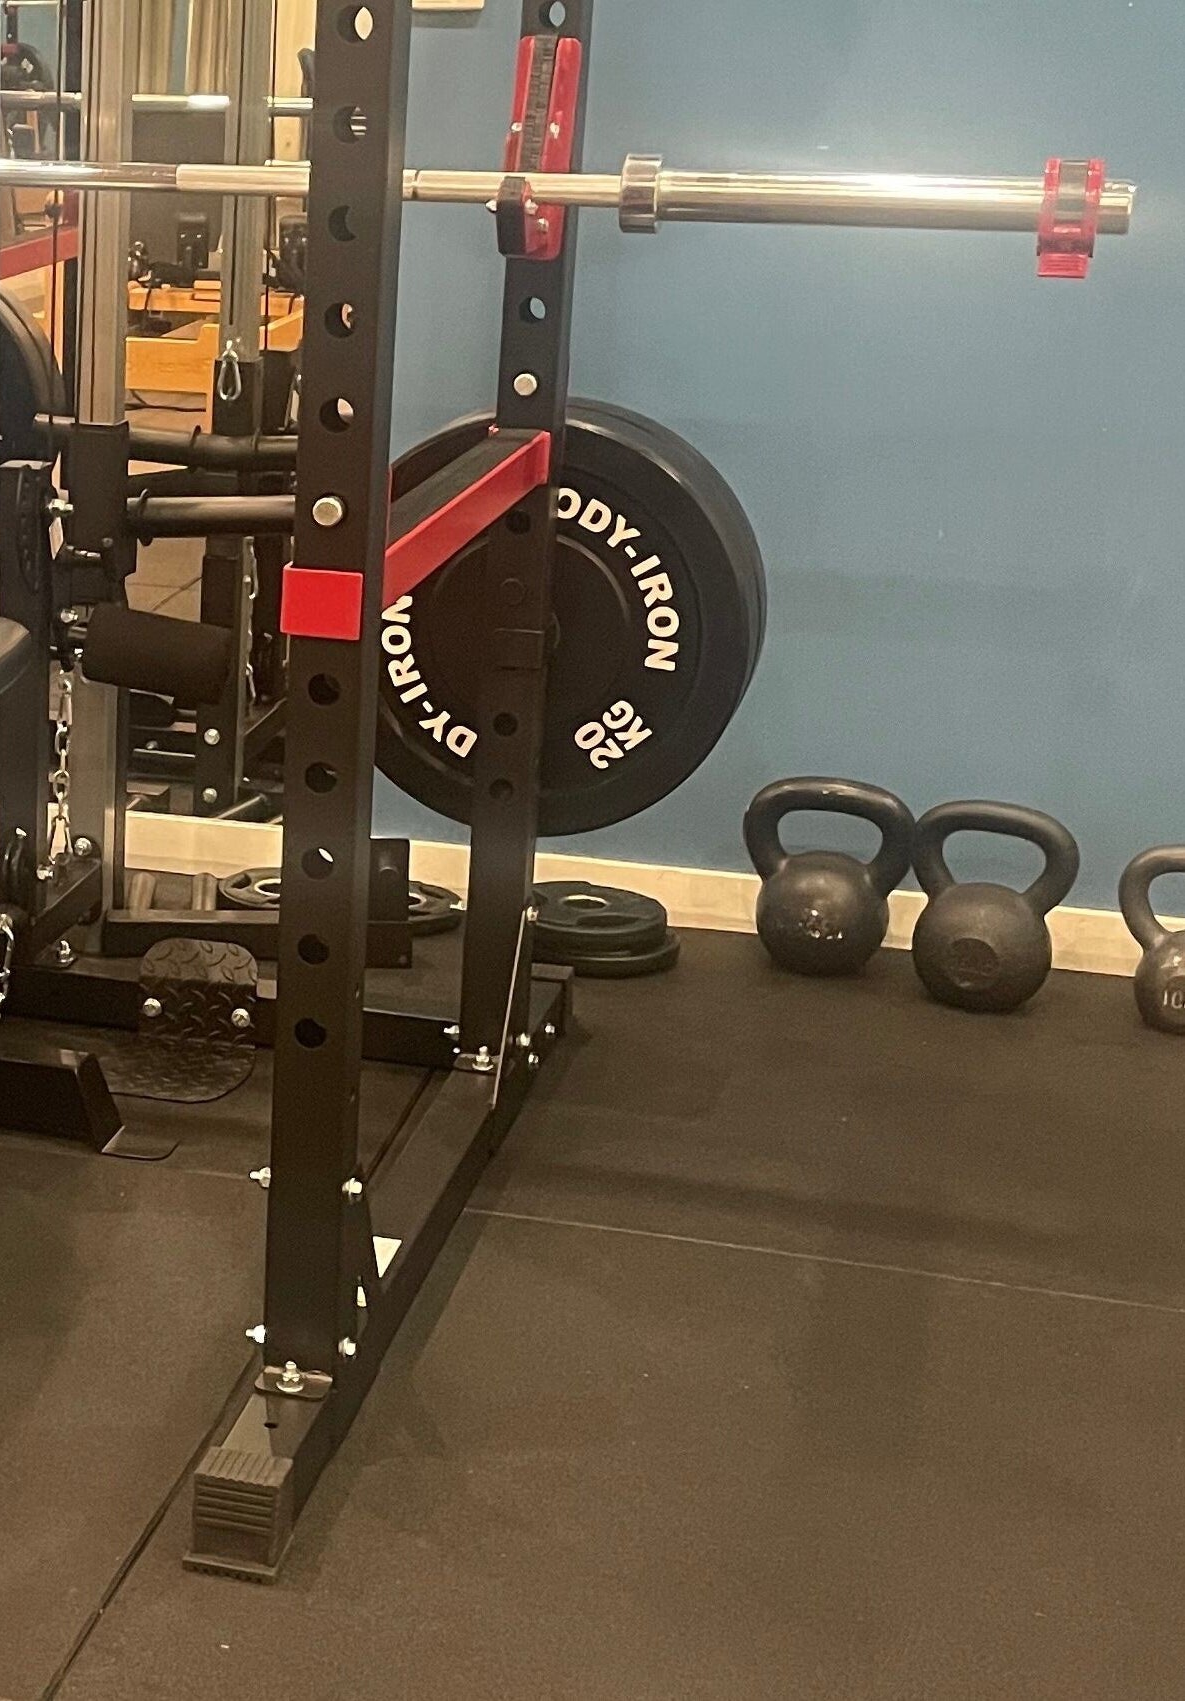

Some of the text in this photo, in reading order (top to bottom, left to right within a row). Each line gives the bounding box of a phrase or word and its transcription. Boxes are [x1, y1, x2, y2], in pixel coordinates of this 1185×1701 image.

[557, 487, 680, 672] ODY-IRON
[381, 595, 478, 758] DY-IRON
[602, 700, 653, 751] KG
[574, 721, 625, 769] 20
